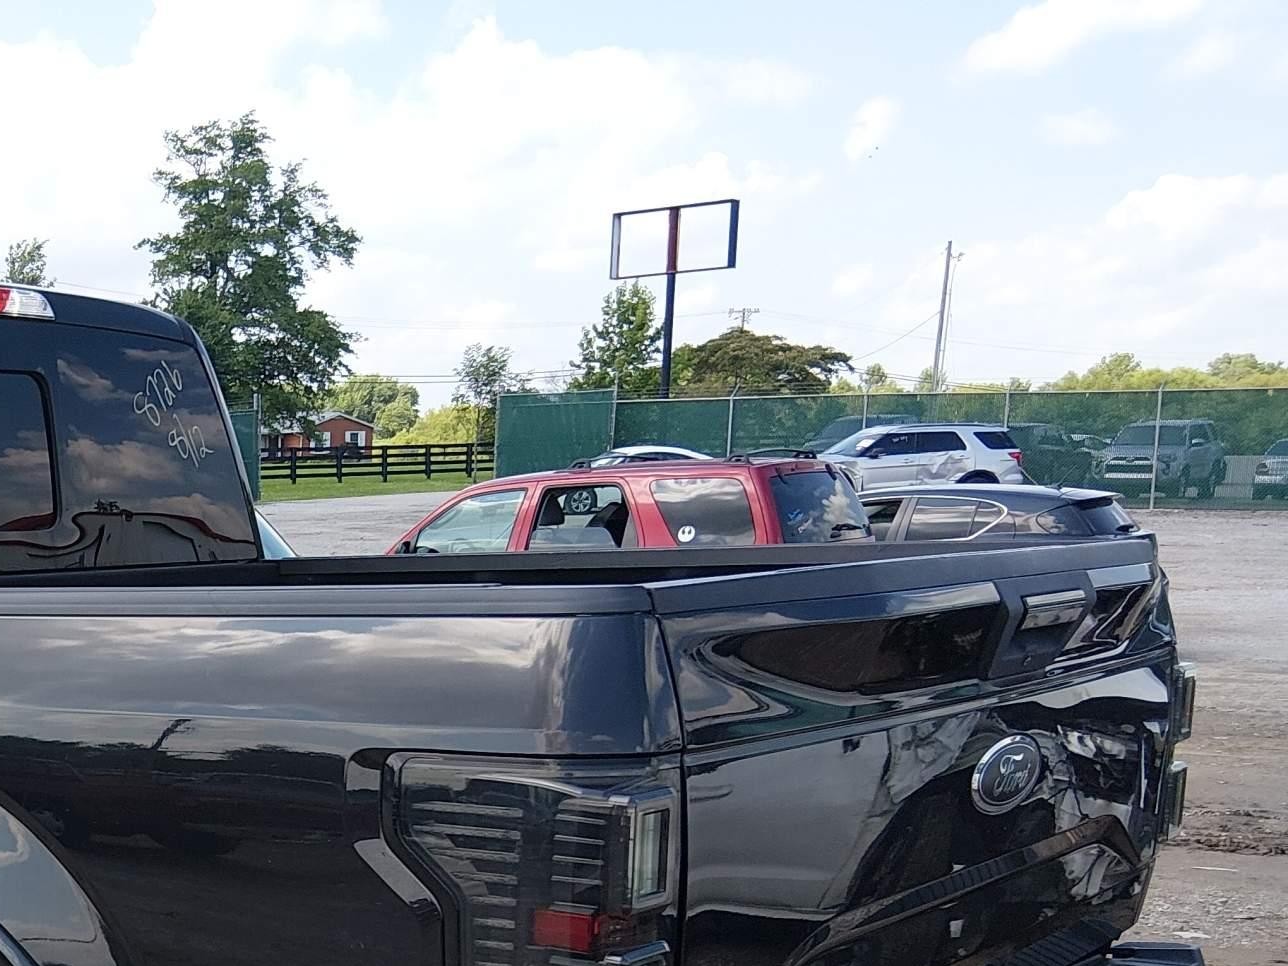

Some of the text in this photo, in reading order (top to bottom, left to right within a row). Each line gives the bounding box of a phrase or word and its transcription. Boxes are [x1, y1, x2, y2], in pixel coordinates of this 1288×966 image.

[133, 360, 183, 426] 8726
[168, 414, 215, 468] 8/12
[993, 752, 1031, 797] Ford
